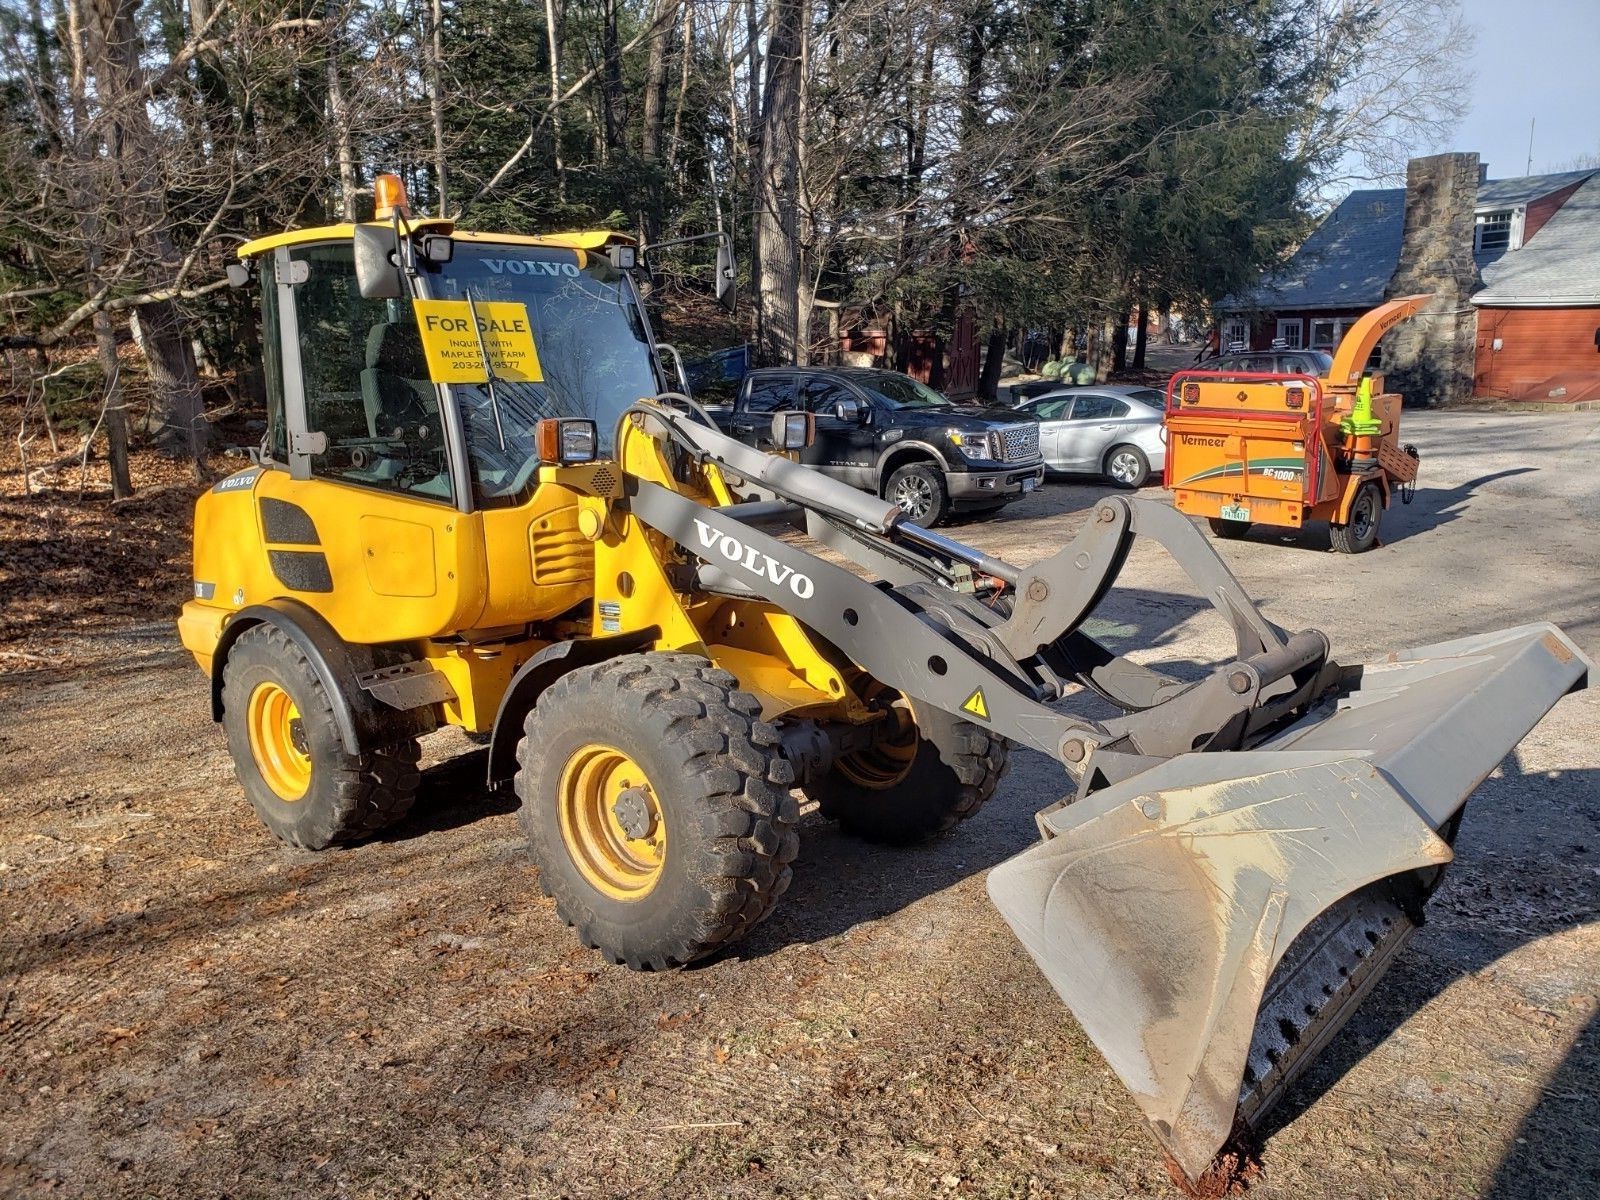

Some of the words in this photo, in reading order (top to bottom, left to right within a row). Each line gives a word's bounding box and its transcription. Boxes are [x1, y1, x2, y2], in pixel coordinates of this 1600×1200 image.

[480, 258, 580, 278] VOLVO
[425, 315, 469, 332] FOR
[476, 317, 526, 333] SALE
[1380, 311, 1402, 330] Vermeer
[490, 340, 513, 348] WITH
[441, 350, 474, 358] MAPLE
[452, 361, 520, 369] 203-26-9577
[1181, 434, 1226, 447] Vermeer
[221, 476, 255, 489] VOLVO
[693, 518, 815, 600] VOLVO
